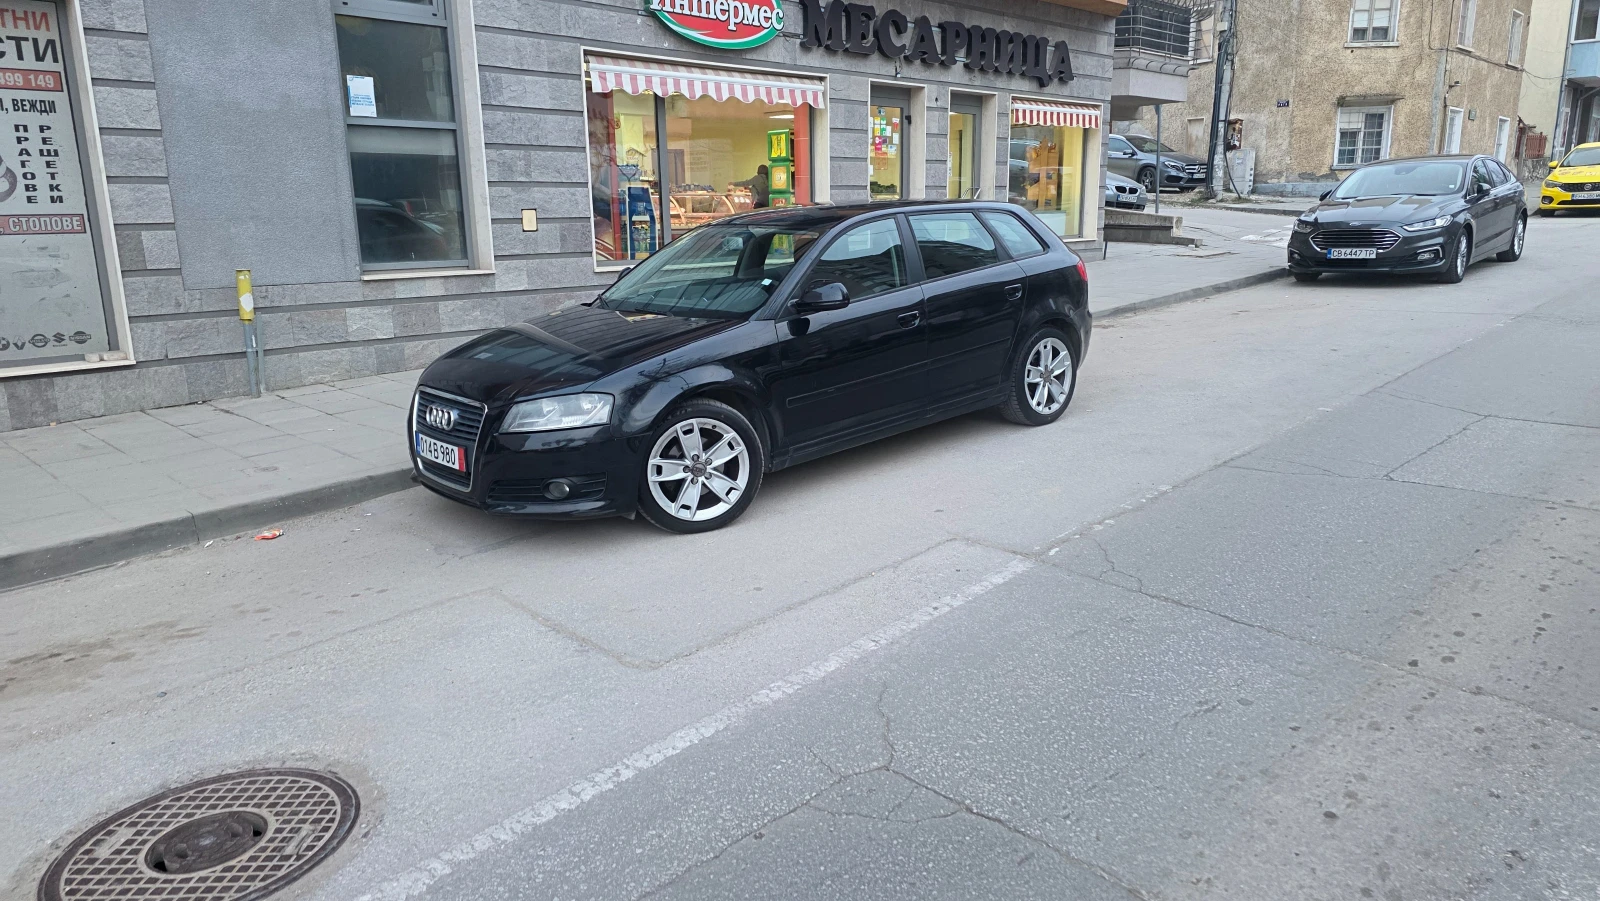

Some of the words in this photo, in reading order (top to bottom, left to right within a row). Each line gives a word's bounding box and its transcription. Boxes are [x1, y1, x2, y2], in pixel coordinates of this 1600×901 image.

[799, 0, 1075, 88] МЕСАРНИЦА
[28, 74, 54, 88] 149
[11, 98, 57, 116] ВЕЖДИ
[14, 124, 39, 204] ПРАГОВЕ
[39, 124, 64, 204] РЕШЕТКИ
[8, 216, 82, 232] СТОПОВЕ
[440, 445, 456, 465] 980
